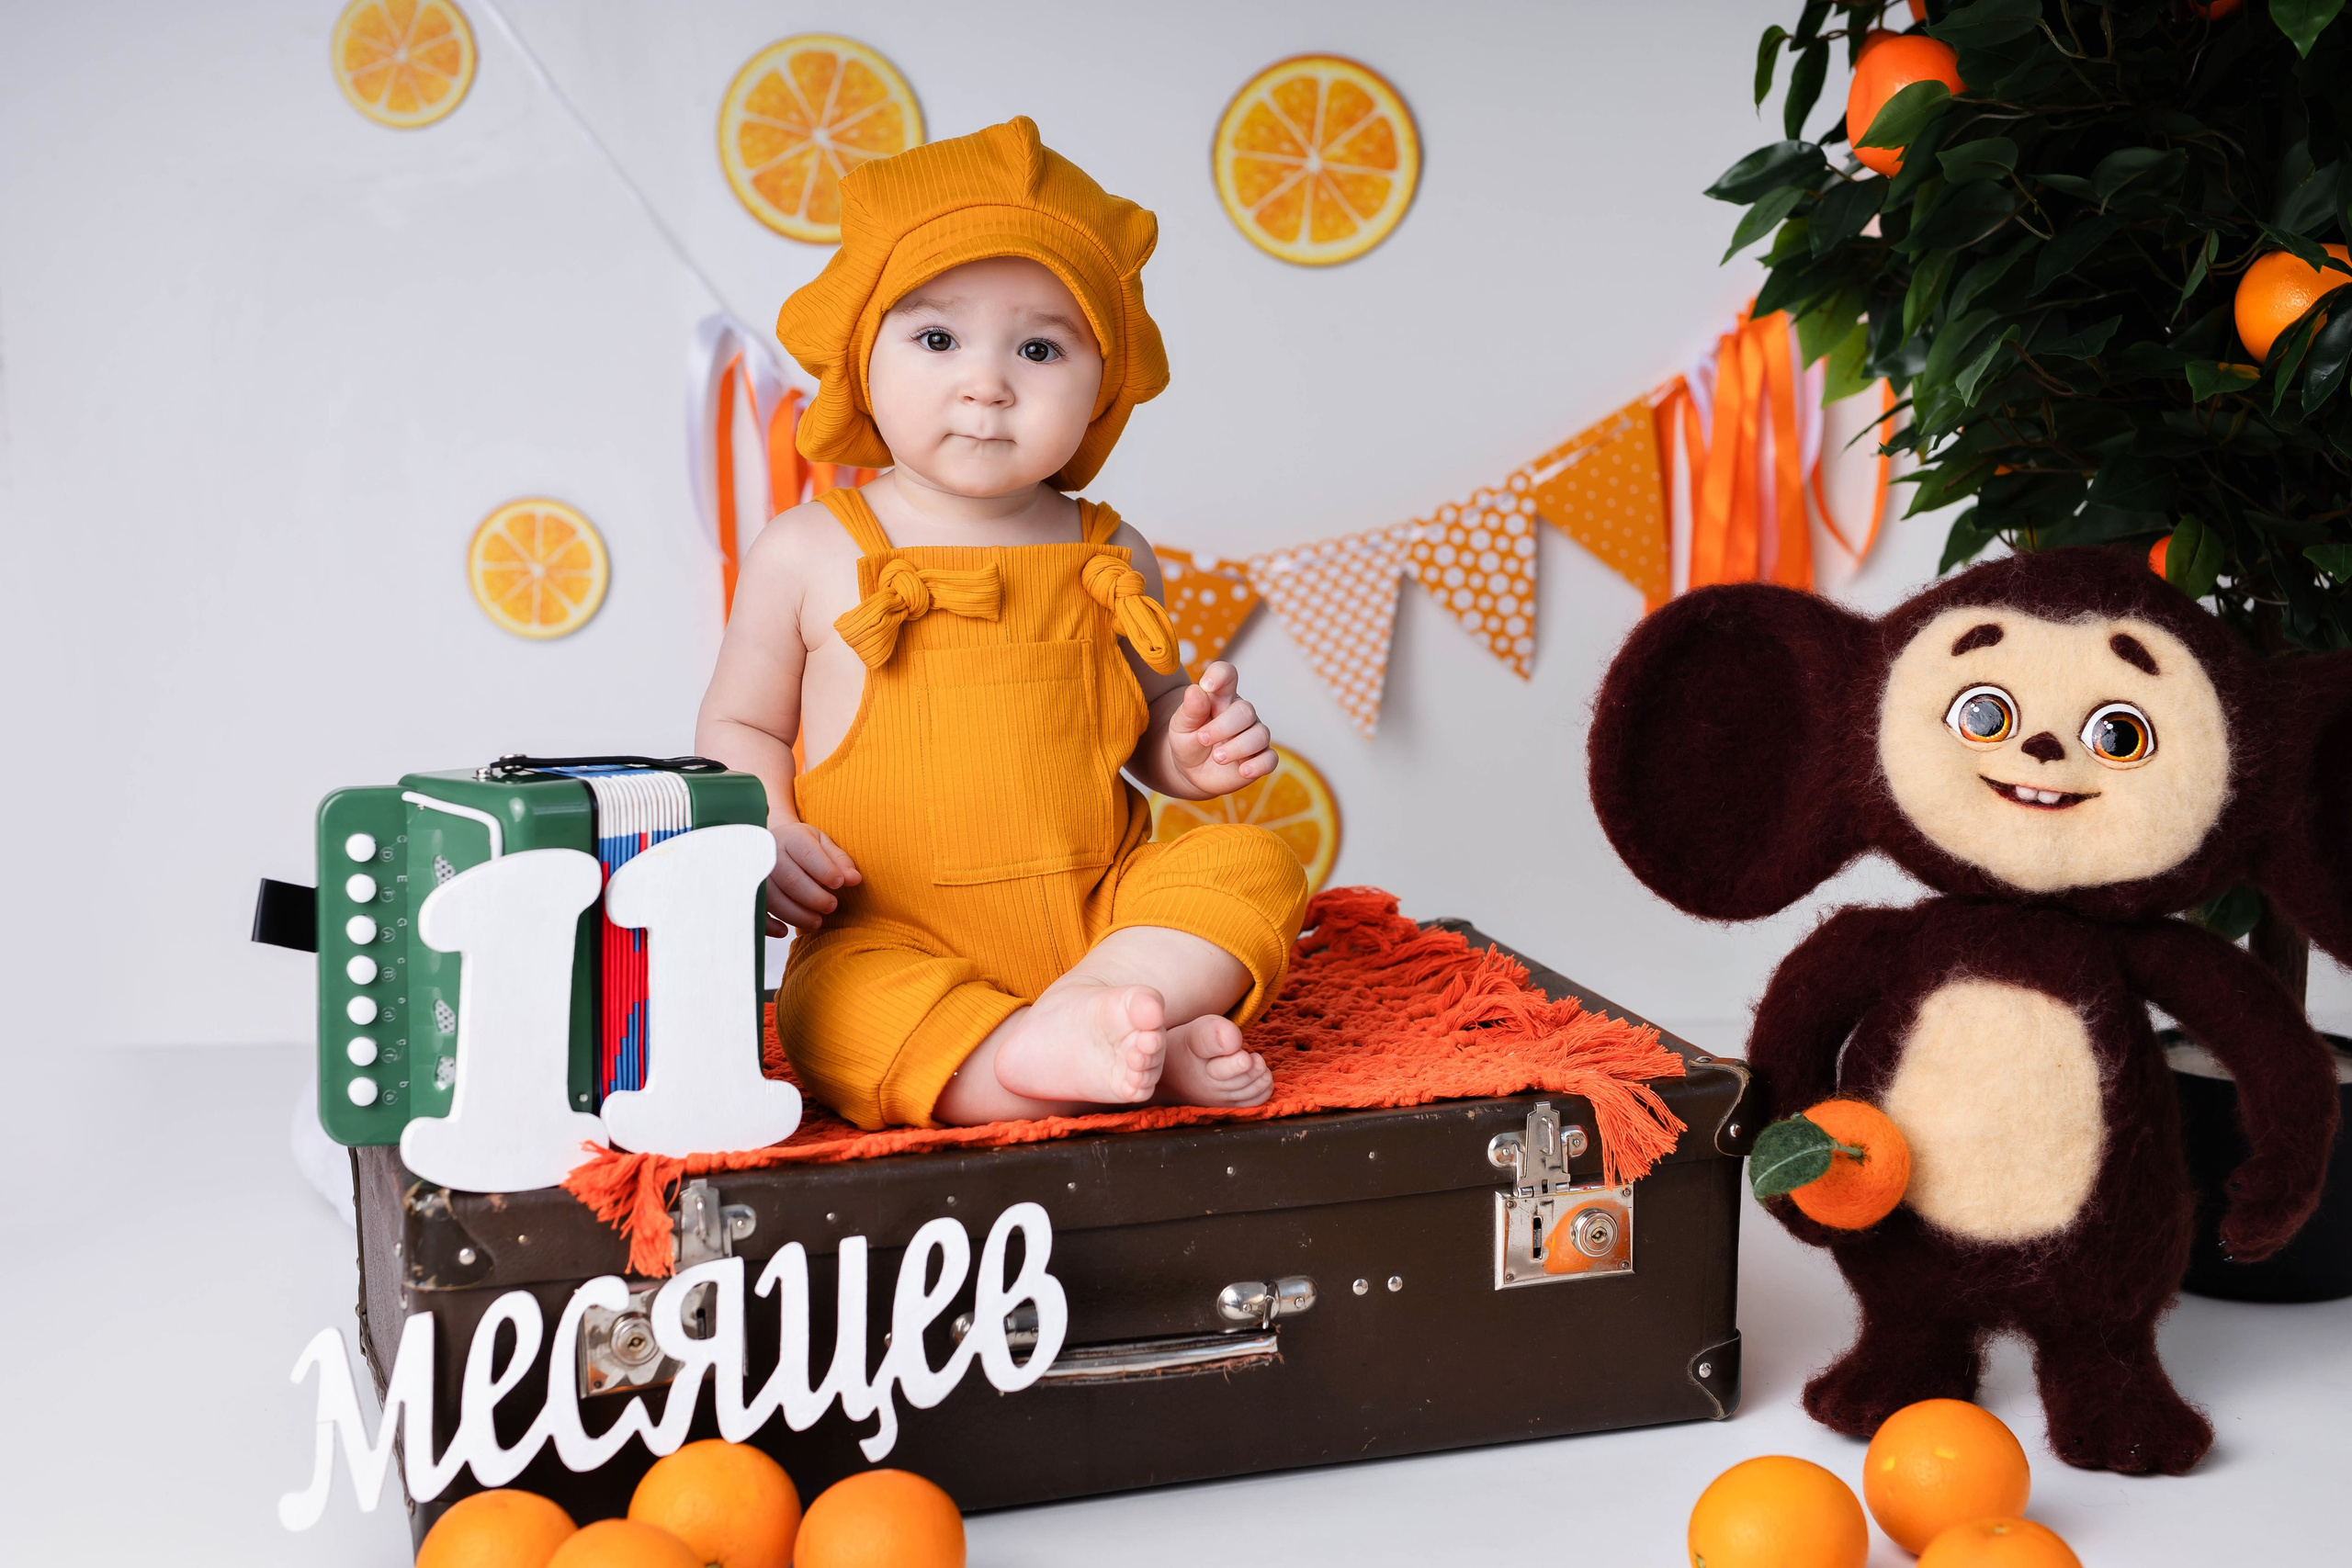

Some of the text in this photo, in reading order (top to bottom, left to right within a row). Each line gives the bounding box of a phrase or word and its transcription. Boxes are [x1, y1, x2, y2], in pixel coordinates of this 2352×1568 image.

[396, 834, 409, 844] C
[396, 874, 409, 884] E
[396, 917, 409, 928] G
[400, 824, 802, 1192] 11
[398, 1080, 410, 1089] b
[277, 1201, 1069, 1533] месяцев
